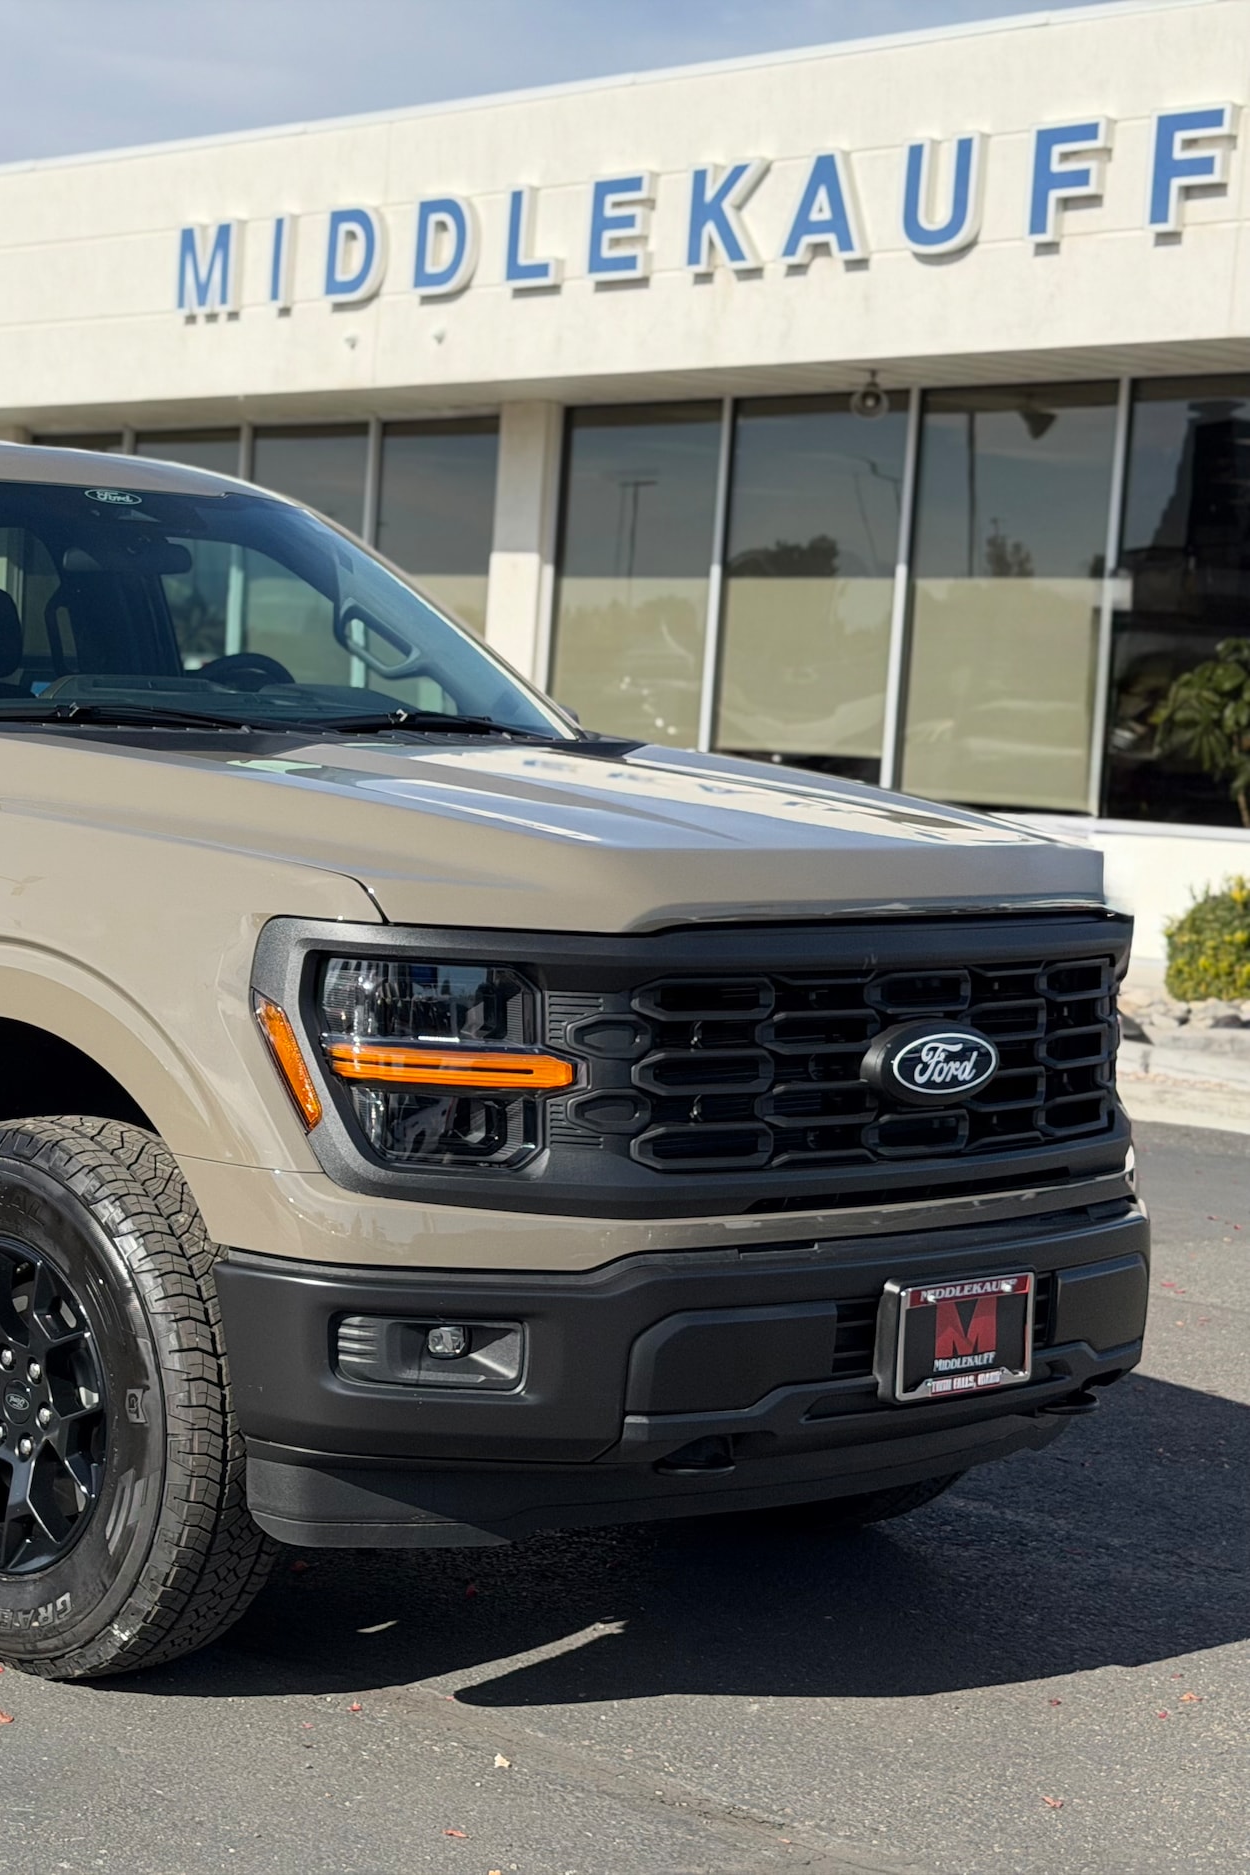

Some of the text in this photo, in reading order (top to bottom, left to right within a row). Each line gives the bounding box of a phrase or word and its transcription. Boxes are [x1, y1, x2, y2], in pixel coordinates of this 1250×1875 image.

[176, 102, 1236, 316] MIDDLEKAUFF
[96, 490, 133, 502] Ford
[914, 1042, 978, 1084] Ford
[933, 1351, 996, 1372] MIDDLEKAUFF
